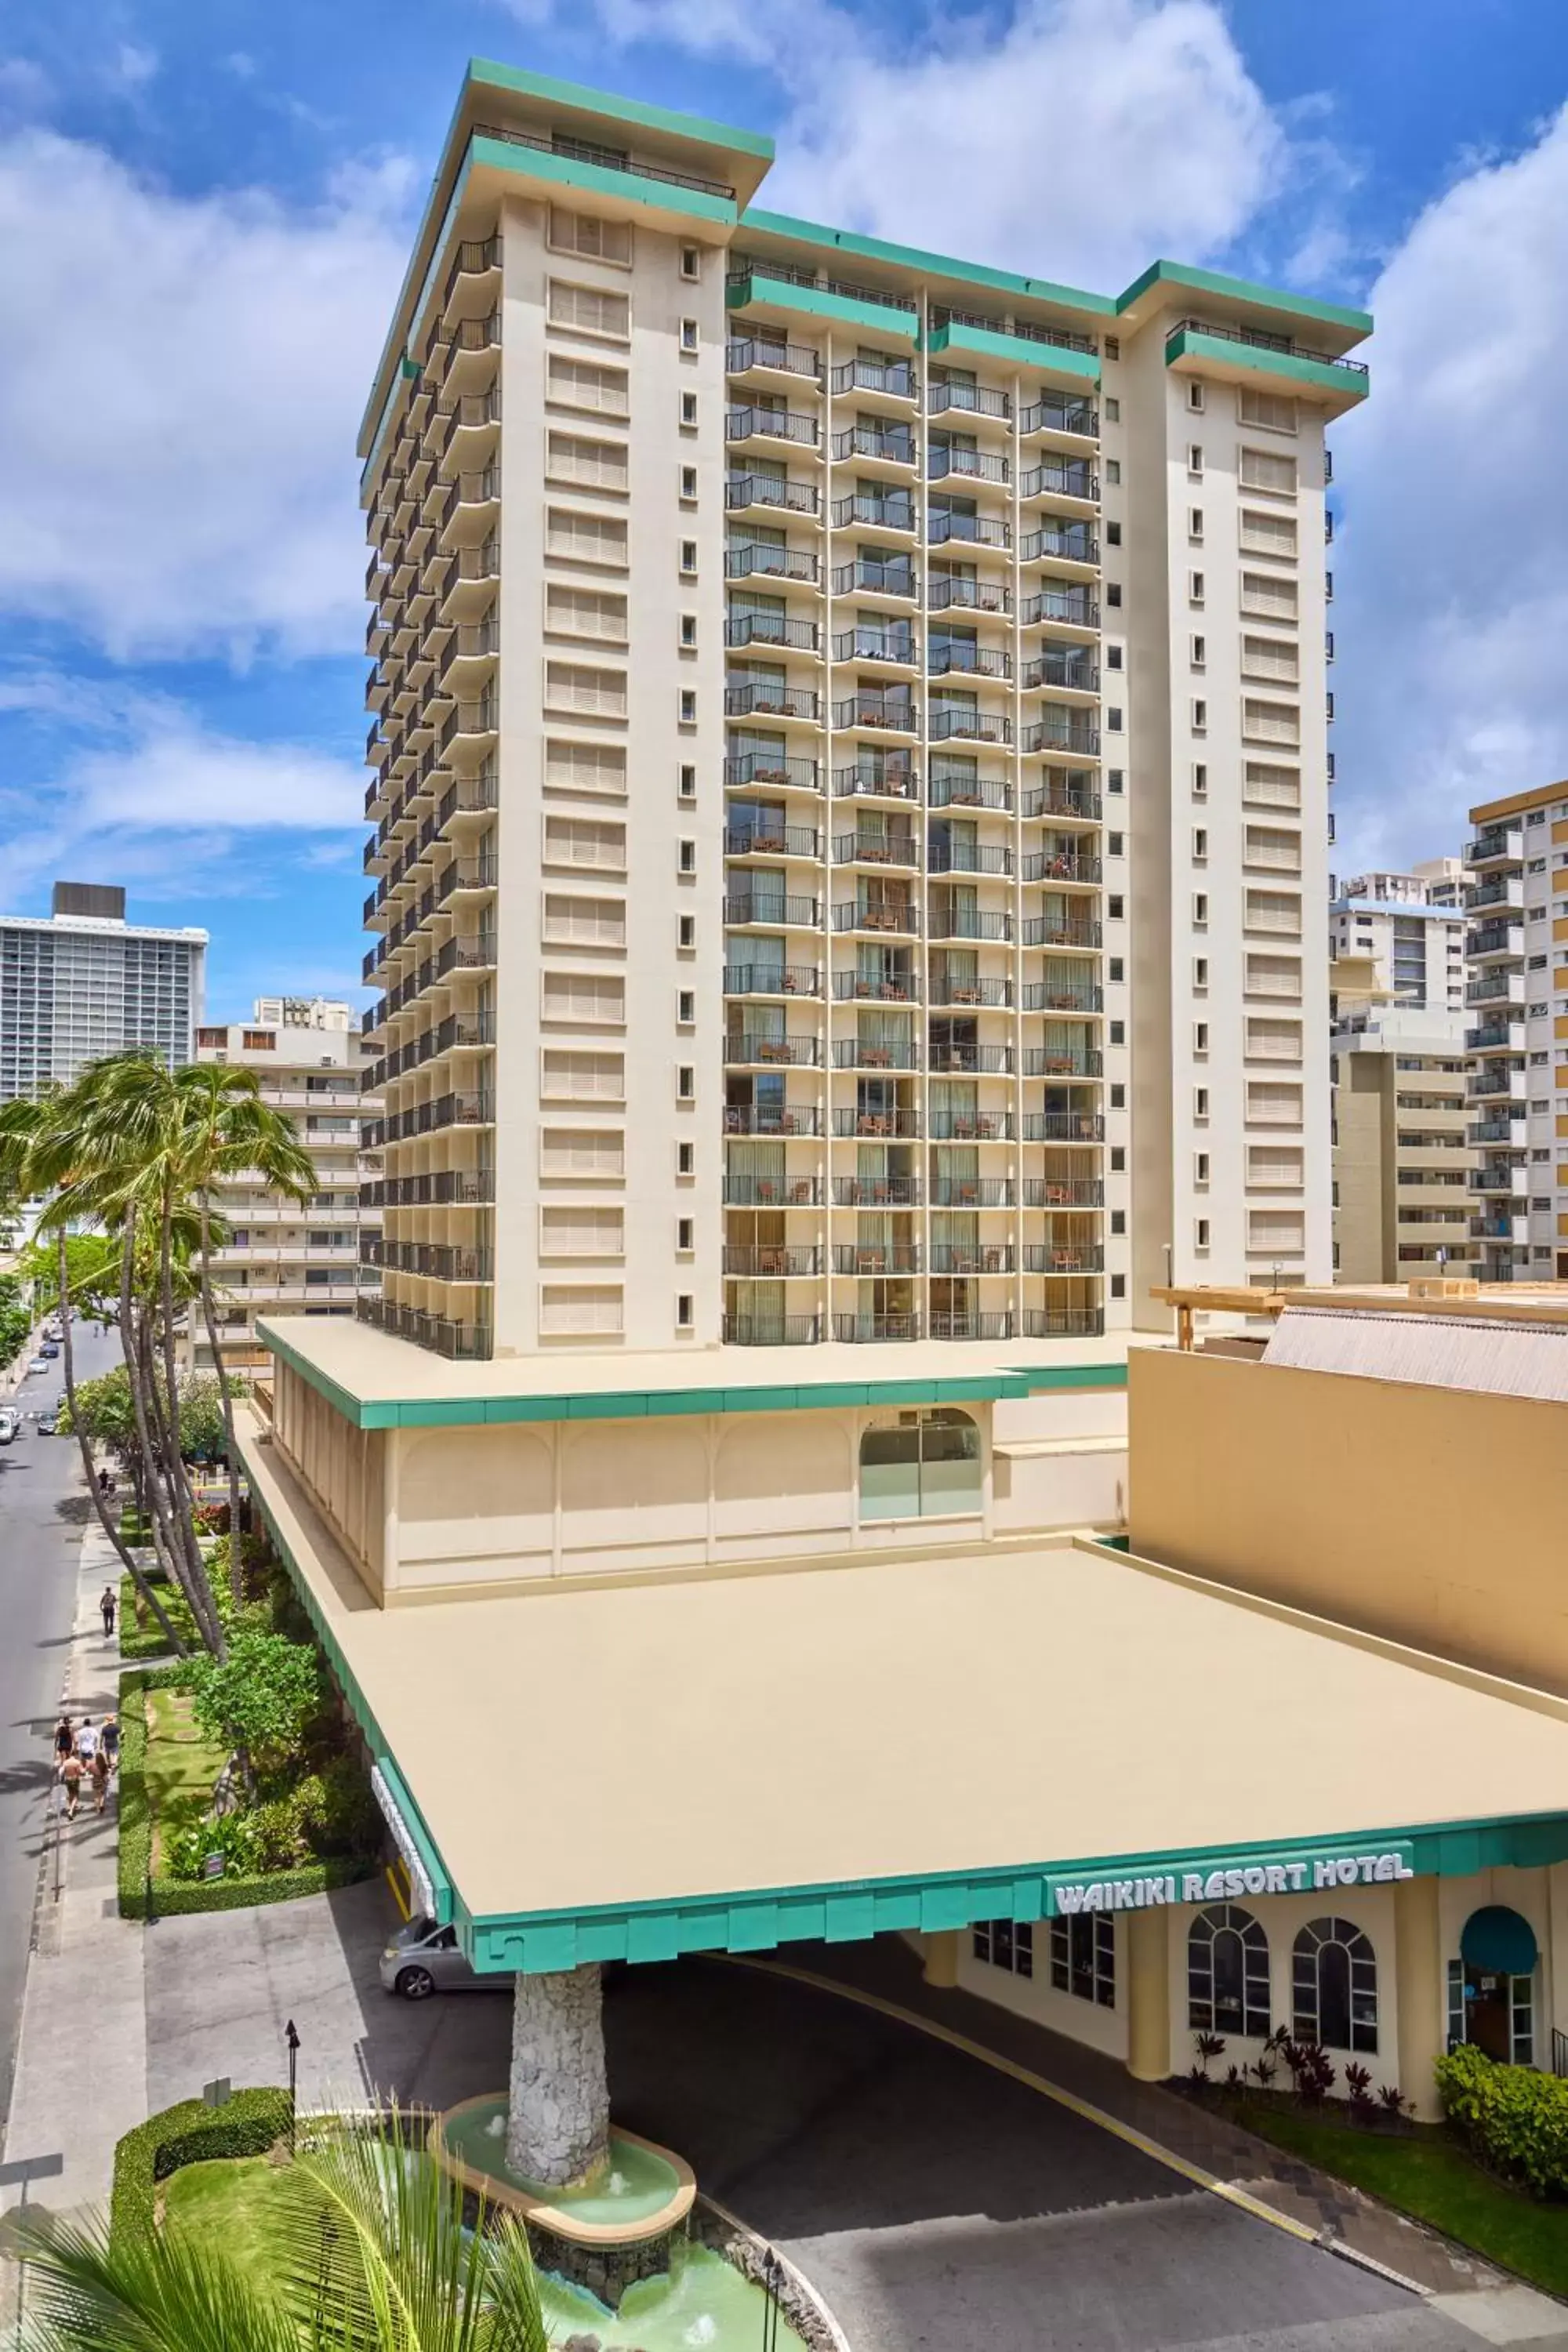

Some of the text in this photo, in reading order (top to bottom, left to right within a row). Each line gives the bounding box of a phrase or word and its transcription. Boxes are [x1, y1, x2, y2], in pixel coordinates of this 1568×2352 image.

[1055, 1853, 1414, 1914] WAIKIKI RESORT HOTEL
